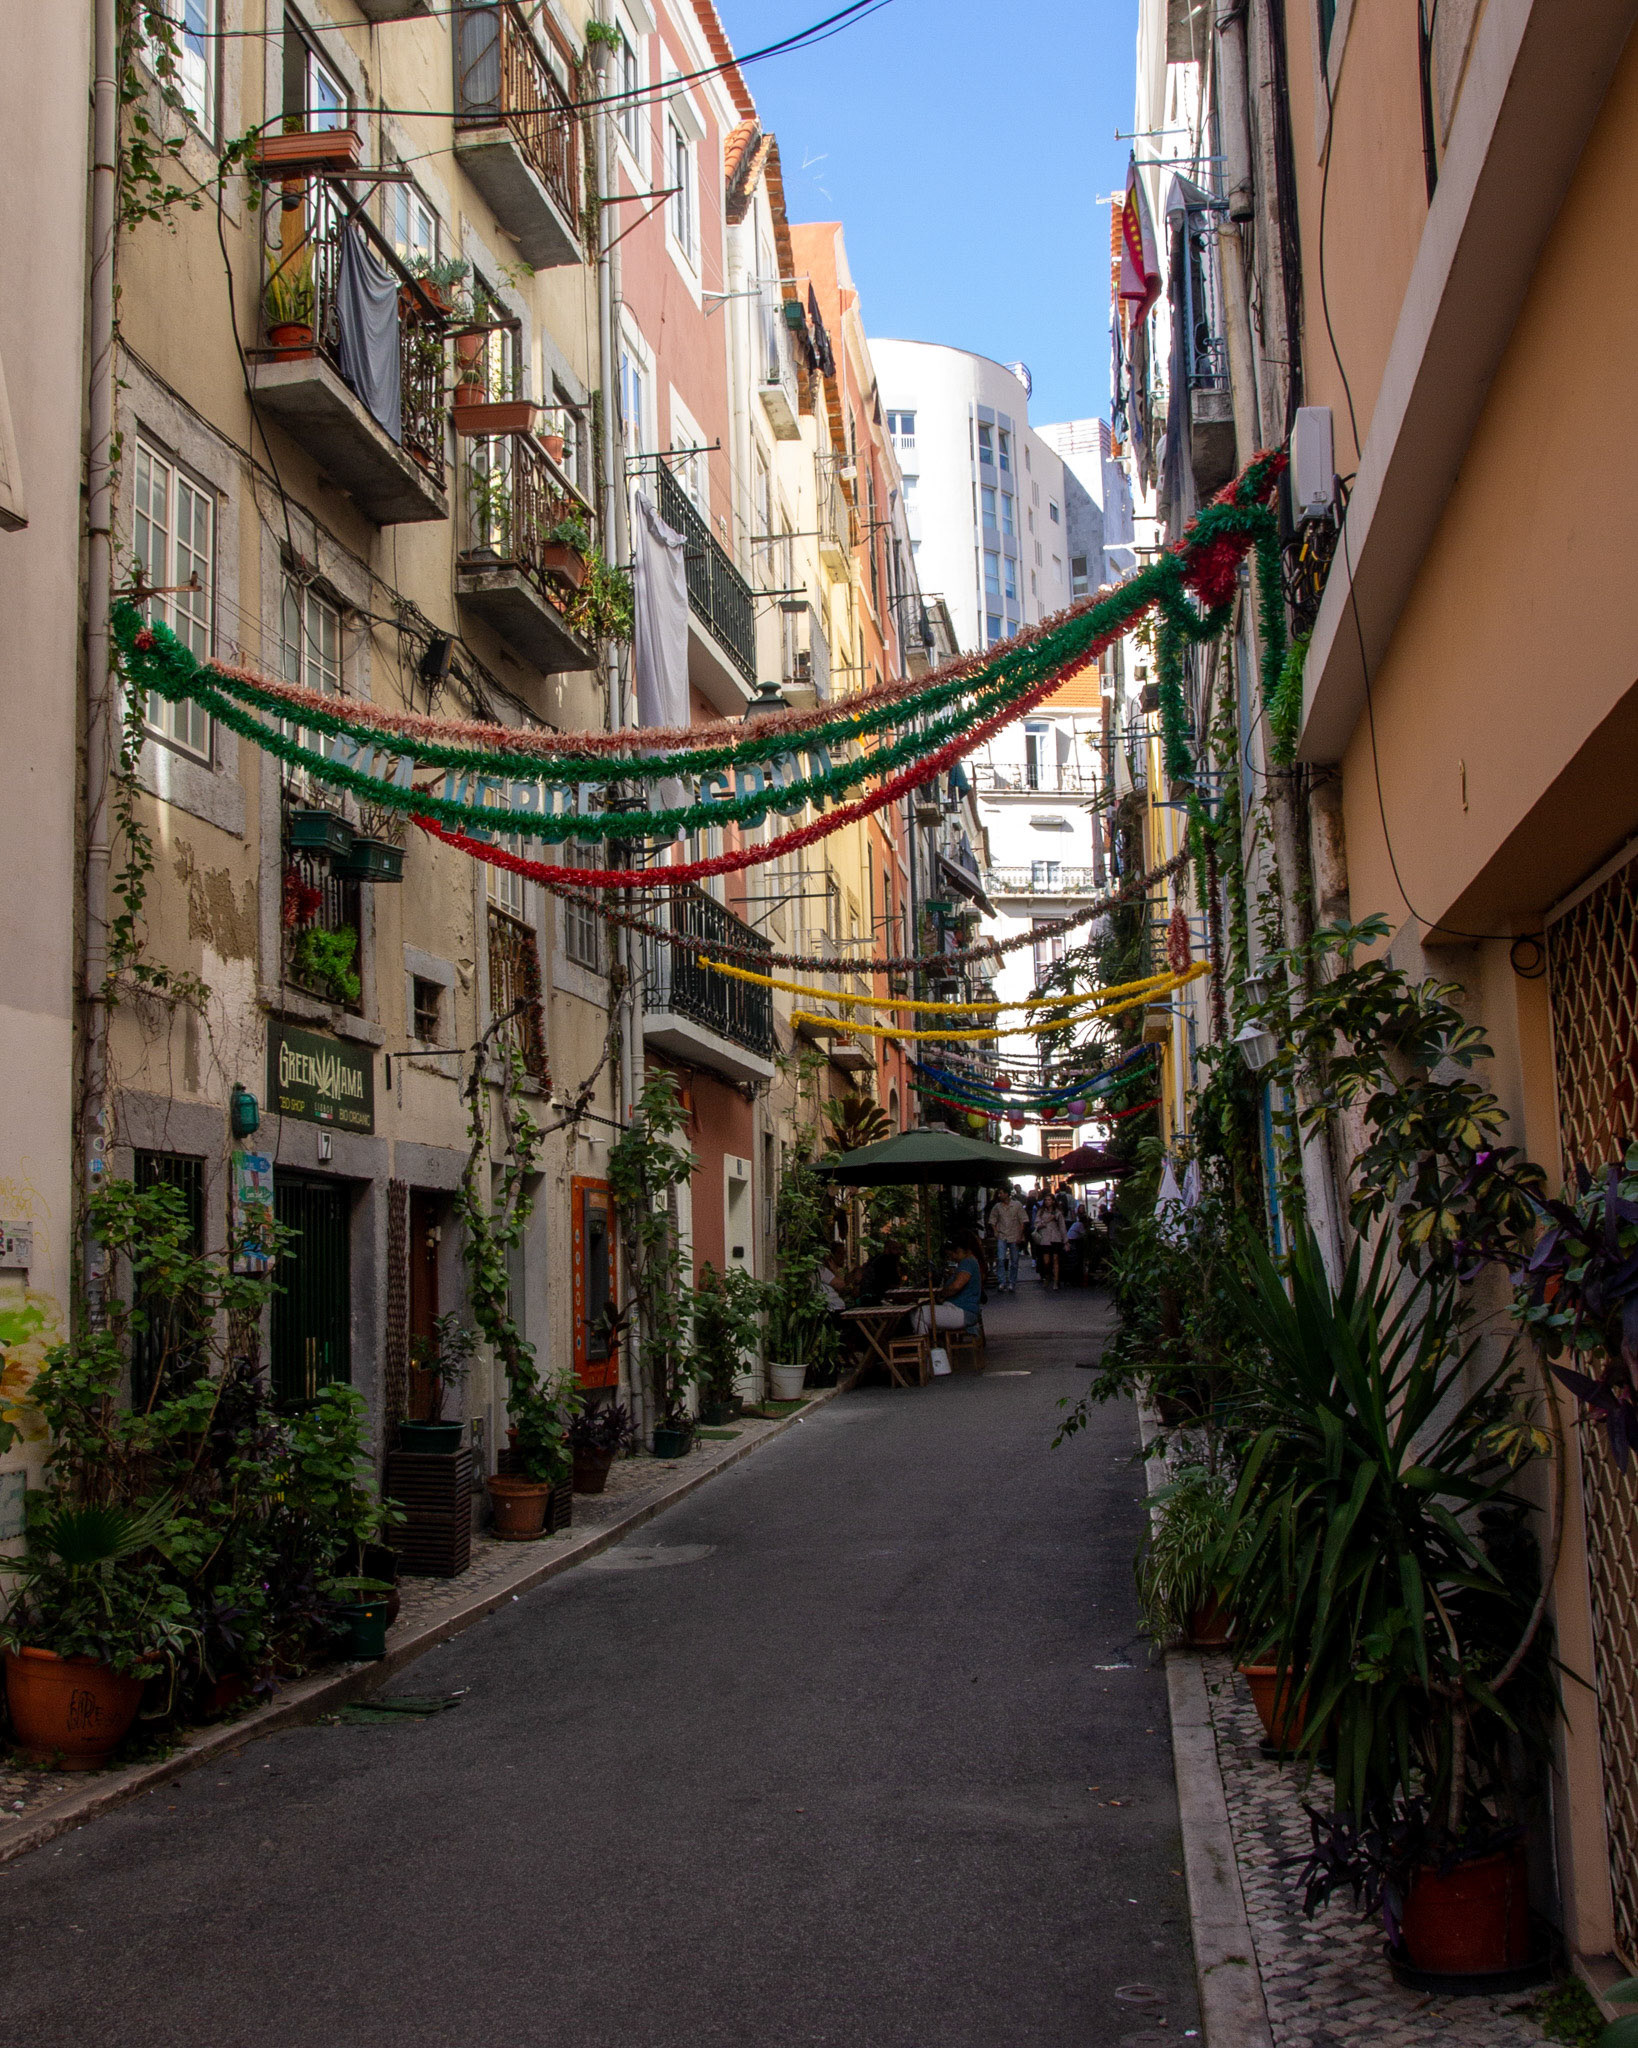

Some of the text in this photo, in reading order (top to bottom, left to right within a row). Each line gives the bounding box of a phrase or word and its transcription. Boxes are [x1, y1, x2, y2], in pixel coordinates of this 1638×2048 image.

[291, 1098, 305, 1112] SHOP
[349, 1110, 371, 1127] ORGANIC
[323, 1135, 330, 1158] 7
